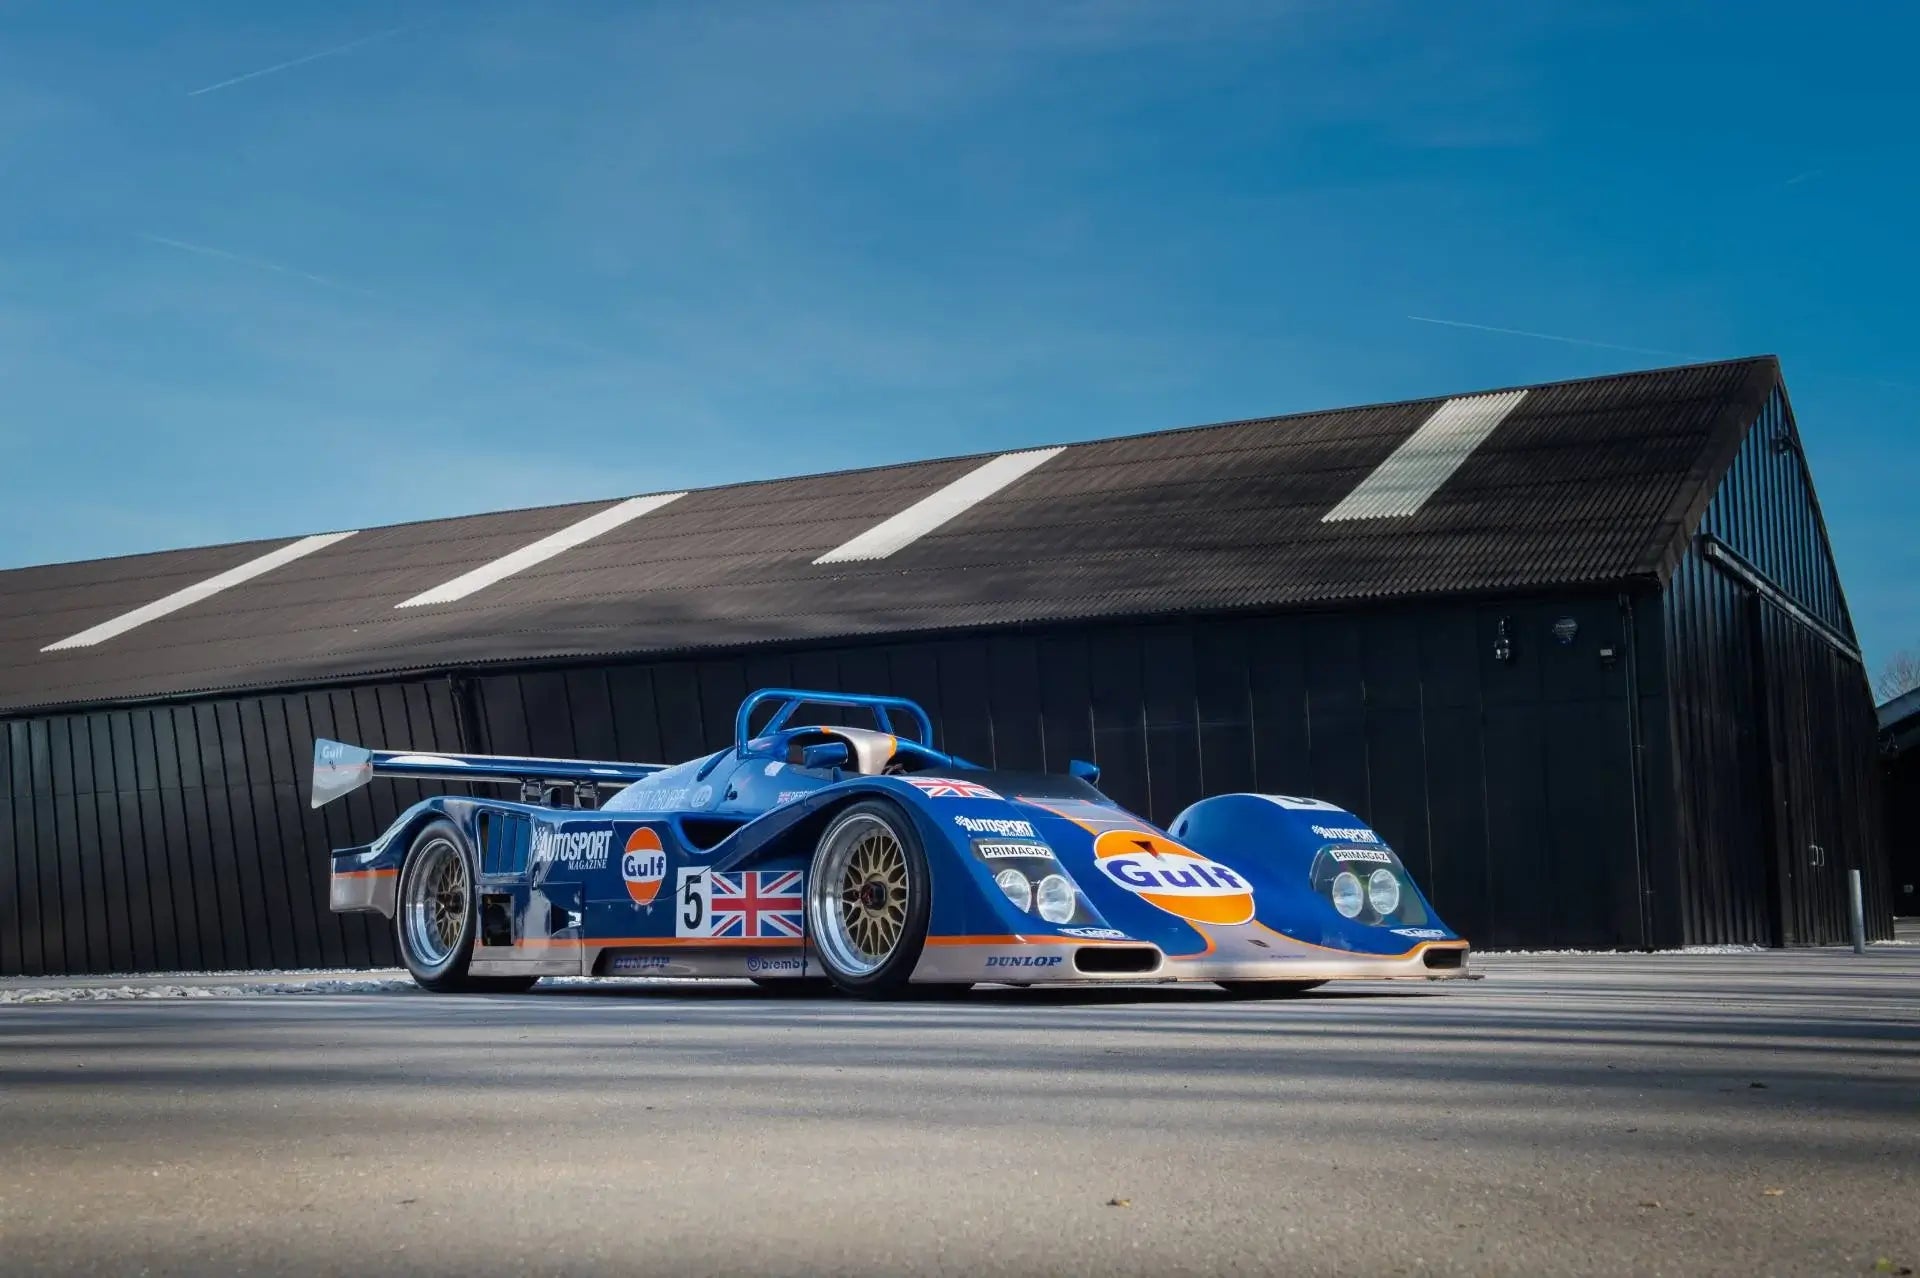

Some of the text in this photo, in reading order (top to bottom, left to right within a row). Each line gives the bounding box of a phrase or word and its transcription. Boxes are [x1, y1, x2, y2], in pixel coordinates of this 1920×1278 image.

[323, 745, 343, 758] Gulf
[965, 818, 1033, 835] AUTOSPORT
[1320, 827, 1376, 841] AUTOSPORT
[537, 830, 612, 862] AUTOSPORT
[983, 847, 1051, 857] PRIMAGAZ
[1334, 852, 1388, 861] PRIMAGAZ
[567, 861, 607, 870] MAGAZINE
[624, 855, 665, 876] Gulf
[1106, 859, 1243, 888] Gulf
[684, 874, 703, 929] 5
[762, 957, 809, 969] brembo
[985, 956, 1063, 967] DUNLOP
